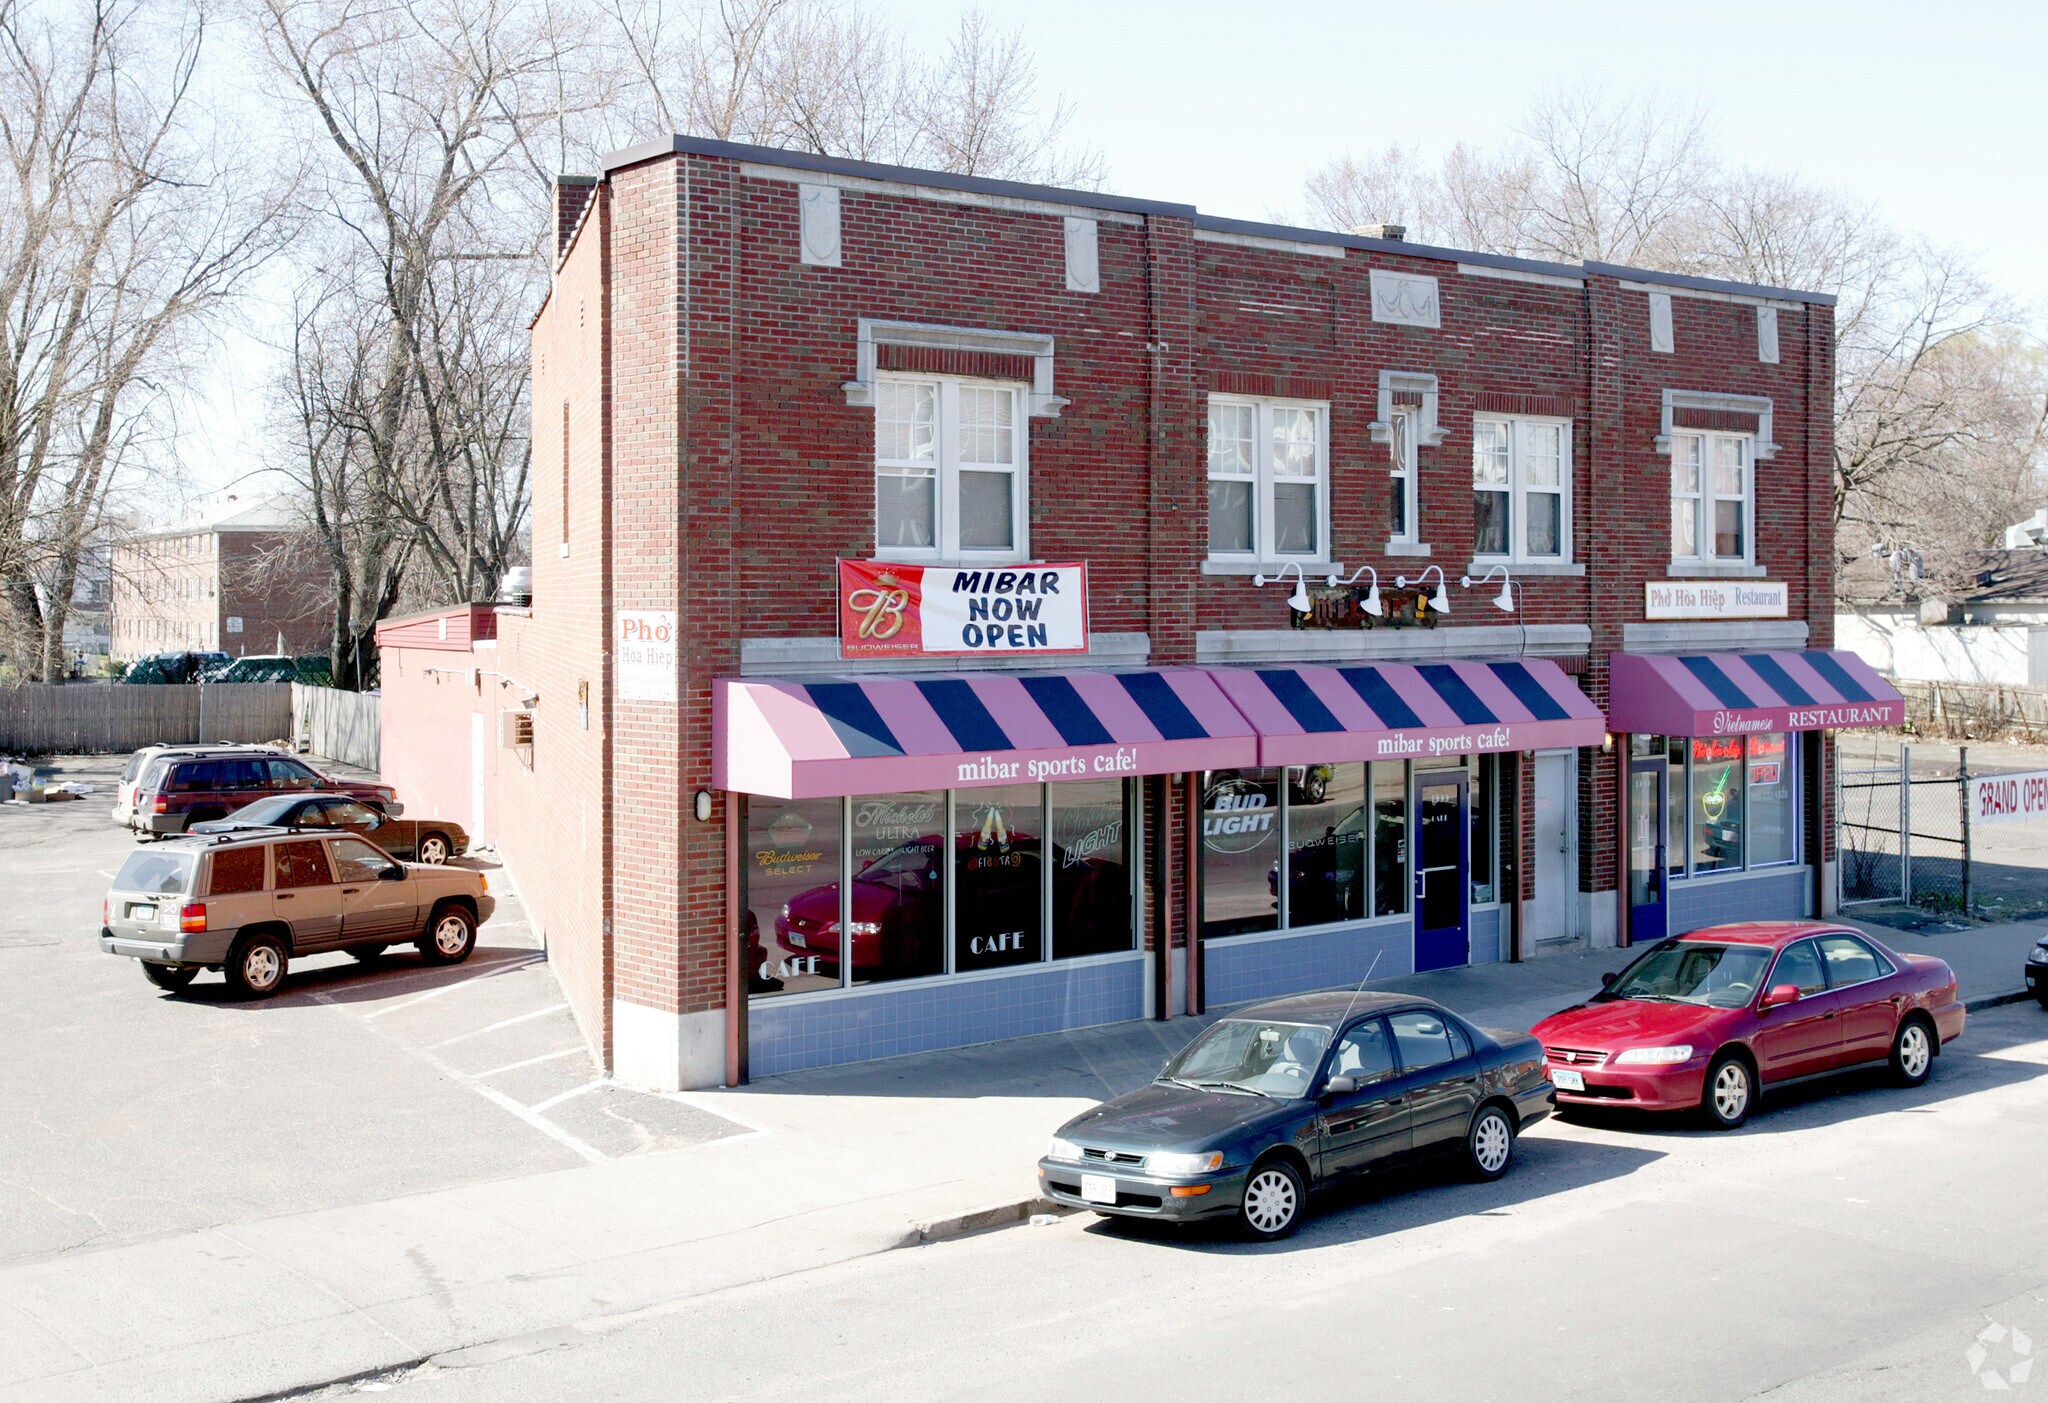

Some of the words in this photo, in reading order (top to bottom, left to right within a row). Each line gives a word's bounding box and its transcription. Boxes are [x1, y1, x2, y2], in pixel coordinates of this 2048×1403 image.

[952, 571, 1060, 595] MIBAR
[1735, 586, 1782, 606] Restaurant
[969, 597, 1043, 622] NOW
[846, 643, 919, 651] BUDWEISER
[962, 622, 1048, 648] OPEN
[1713, 710, 1773, 734] Vietnamese
[1788, 706, 1892, 727] RESTAURANT
[1377, 733, 1424, 755] mibar
[1428, 734, 1473, 756] sports
[957, 756, 1020, 781] mibar
[1027, 756, 1087, 782] sports
[1213, 793, 1267, 813] BUD
[1979, 780, 2017, 817] GRAND
[855, 801, 936, 828] Michelob
[1204, 813, 1274, 836] LIGHT
[876, 826, 920, 840] ULTRA
[1063, 820, 1123, 869] LIGHT
[755, 850, 823, 866] Budweiser
[855, 848, 871, 857] LOW
[901, 845, 920, 854] LIGHT
[921, 845, 935, 853] BEER
[765, 864, 812, 876] SELECT
[970, 931, 1025, 955] CAFE
[758, 955, 821, 981] CAFE
